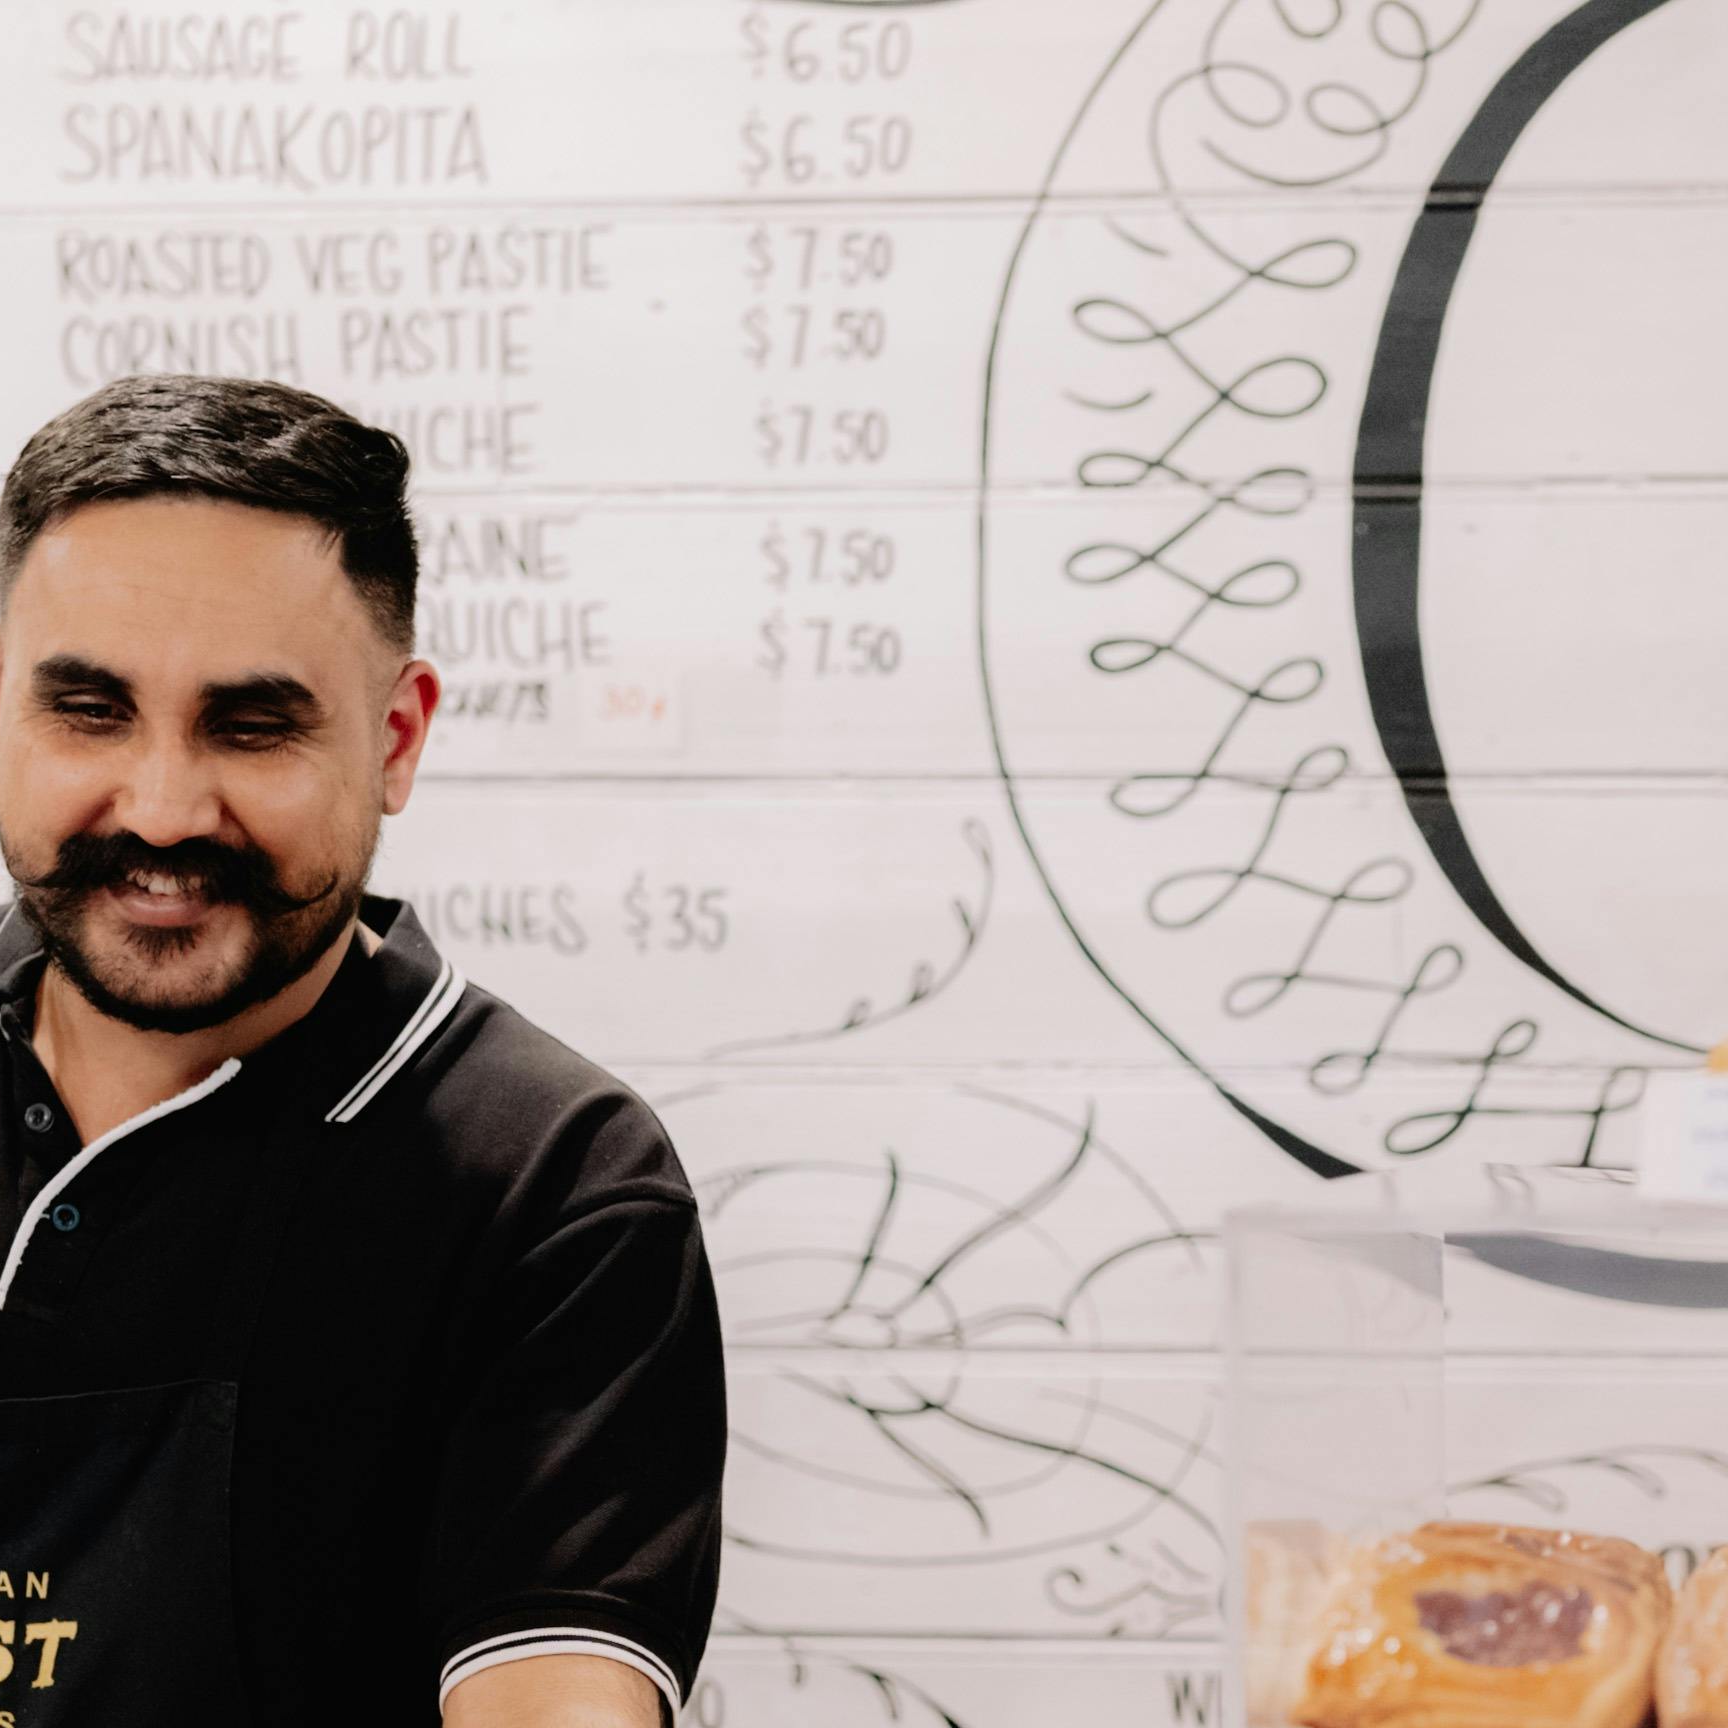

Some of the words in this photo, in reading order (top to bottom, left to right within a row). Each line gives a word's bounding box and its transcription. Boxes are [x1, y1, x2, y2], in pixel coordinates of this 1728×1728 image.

[60, 11, 304, 83] SAUSAGE
[344, 9, 474, 81] ROLL
[58, 104, 490, 193] SPANAKOPITA
[55, 230, 273, 304] ROASTED
[294, 231, 404, 296] VEG
[425, 222, 615, 296] PASTIE
[338, 304, 533, 379] PASTIE
[623, 868, 731, 956] $35
